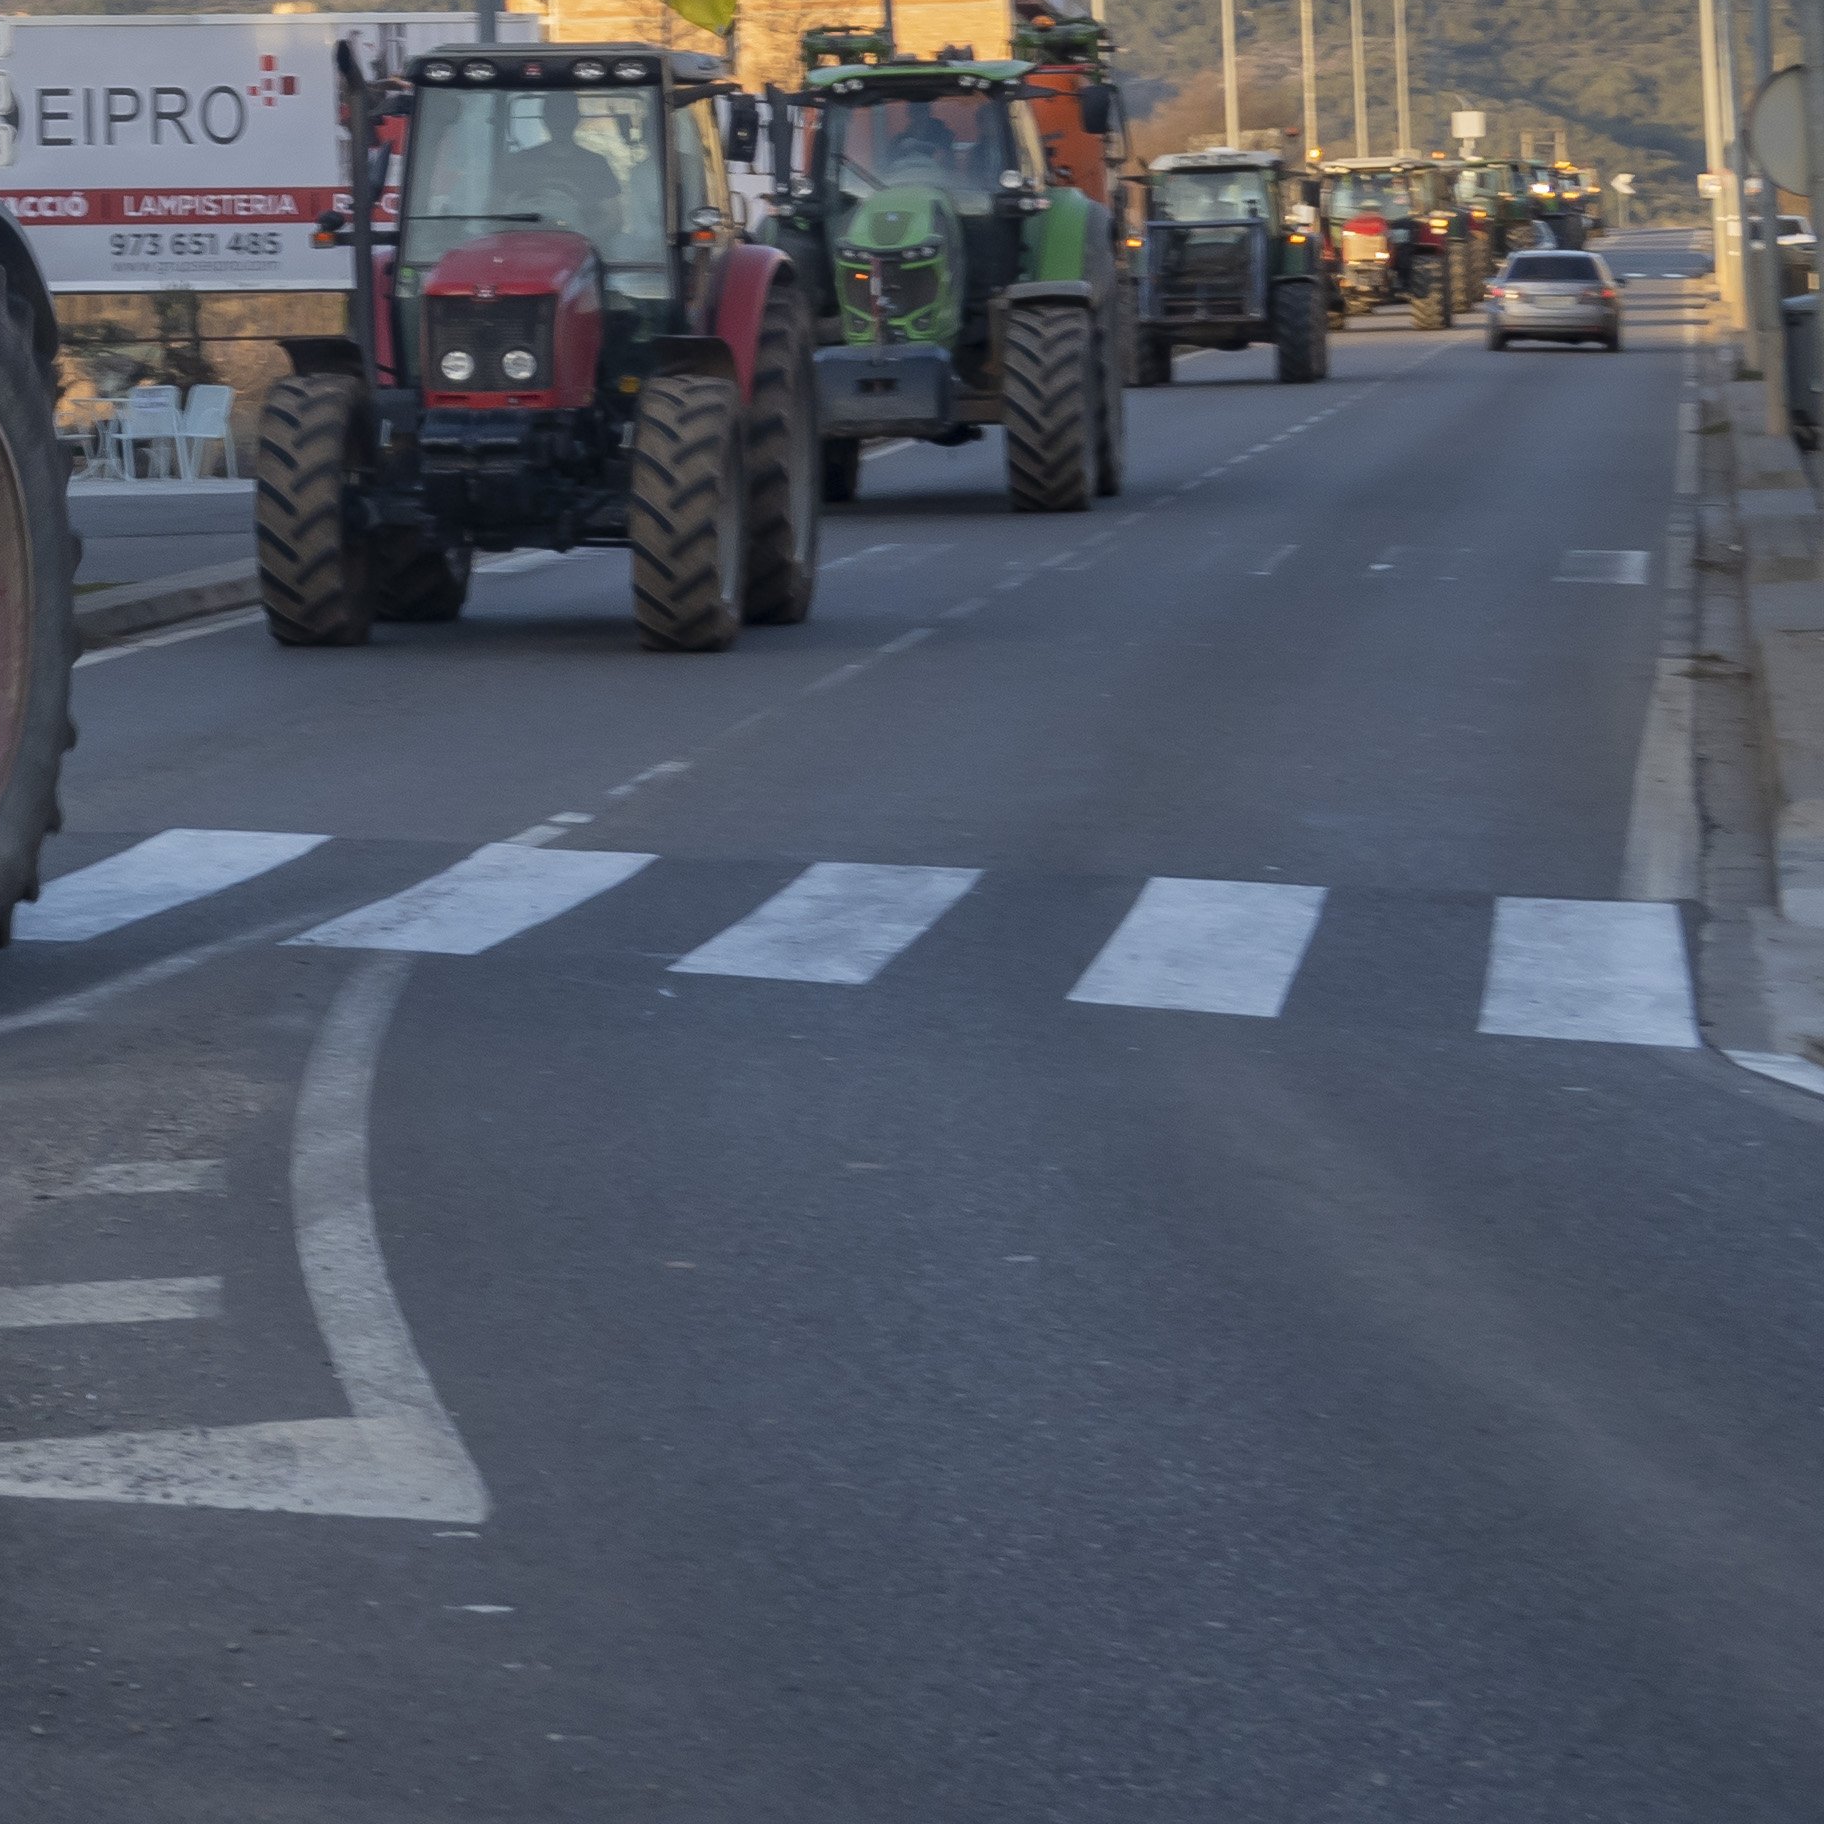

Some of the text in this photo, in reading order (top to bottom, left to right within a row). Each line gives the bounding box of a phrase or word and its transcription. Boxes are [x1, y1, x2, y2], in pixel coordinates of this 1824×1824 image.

[0, 85, 246, 146] EIPRO
[123, 194, 299, 216] LAMPISTERIA
[110, 231, 283, 256] 973 651 485
